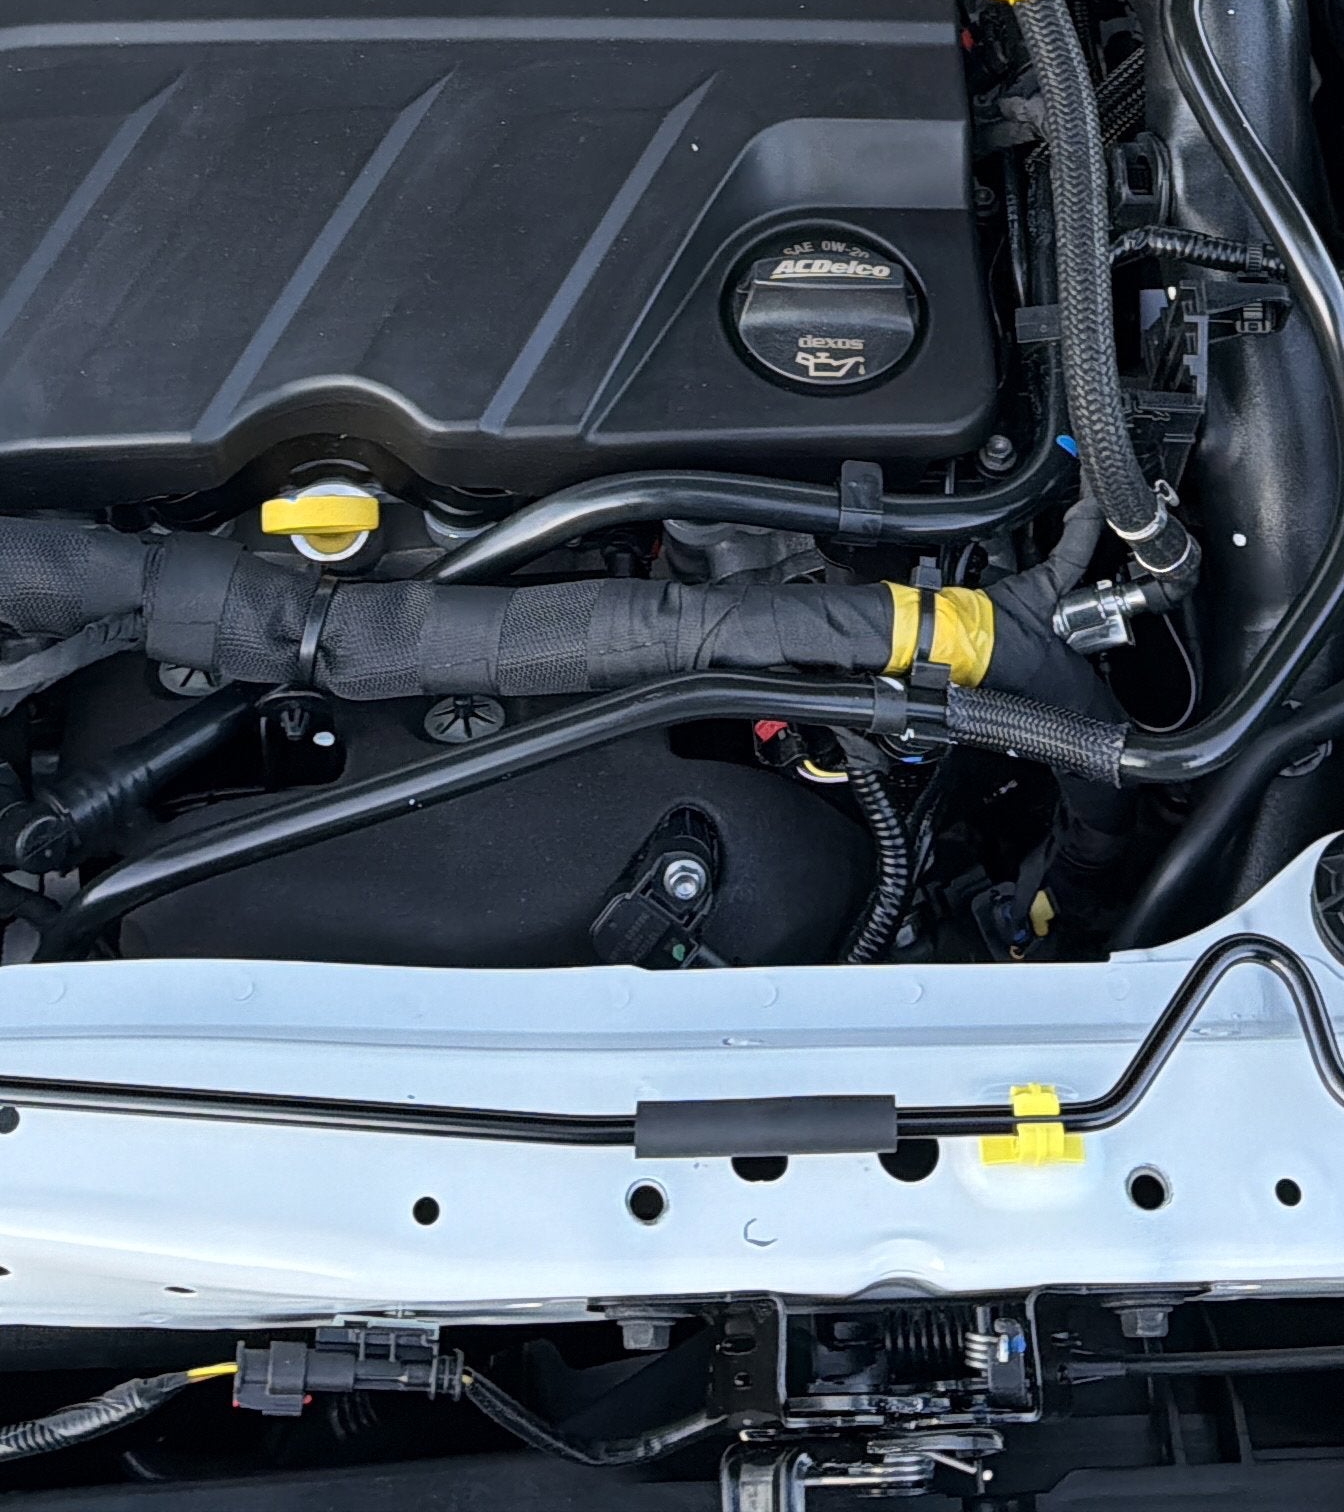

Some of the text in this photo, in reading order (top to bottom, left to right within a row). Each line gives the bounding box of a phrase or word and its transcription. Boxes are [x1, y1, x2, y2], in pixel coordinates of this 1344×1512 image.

[783, 241, 815, 255] SAE
[771, 259, 891, 277] ACDelco
[798, 335, 864, 350] dexos
